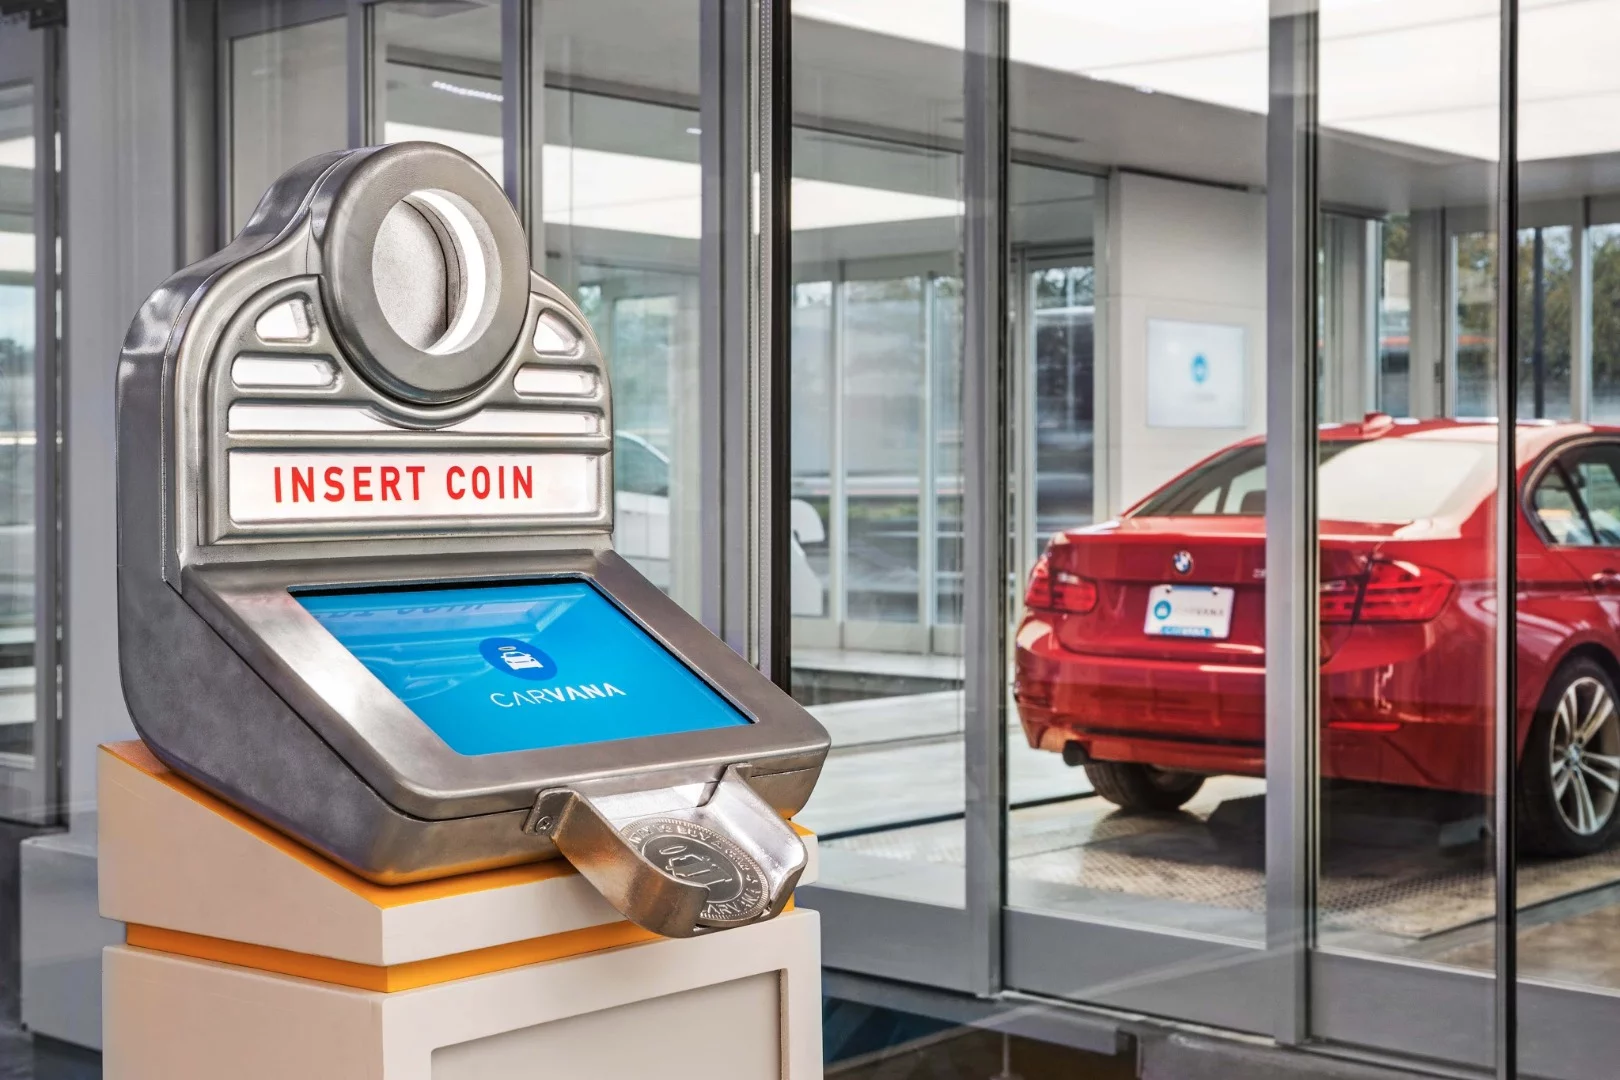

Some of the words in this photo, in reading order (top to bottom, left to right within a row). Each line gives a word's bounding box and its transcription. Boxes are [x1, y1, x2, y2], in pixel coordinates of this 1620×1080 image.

[274, 466, 426, 503] INSERT
[446, 465, 533, 500] COIN
[489, 682, 627, 708] CARVANA
[677, 825, 710, 841] BUY
